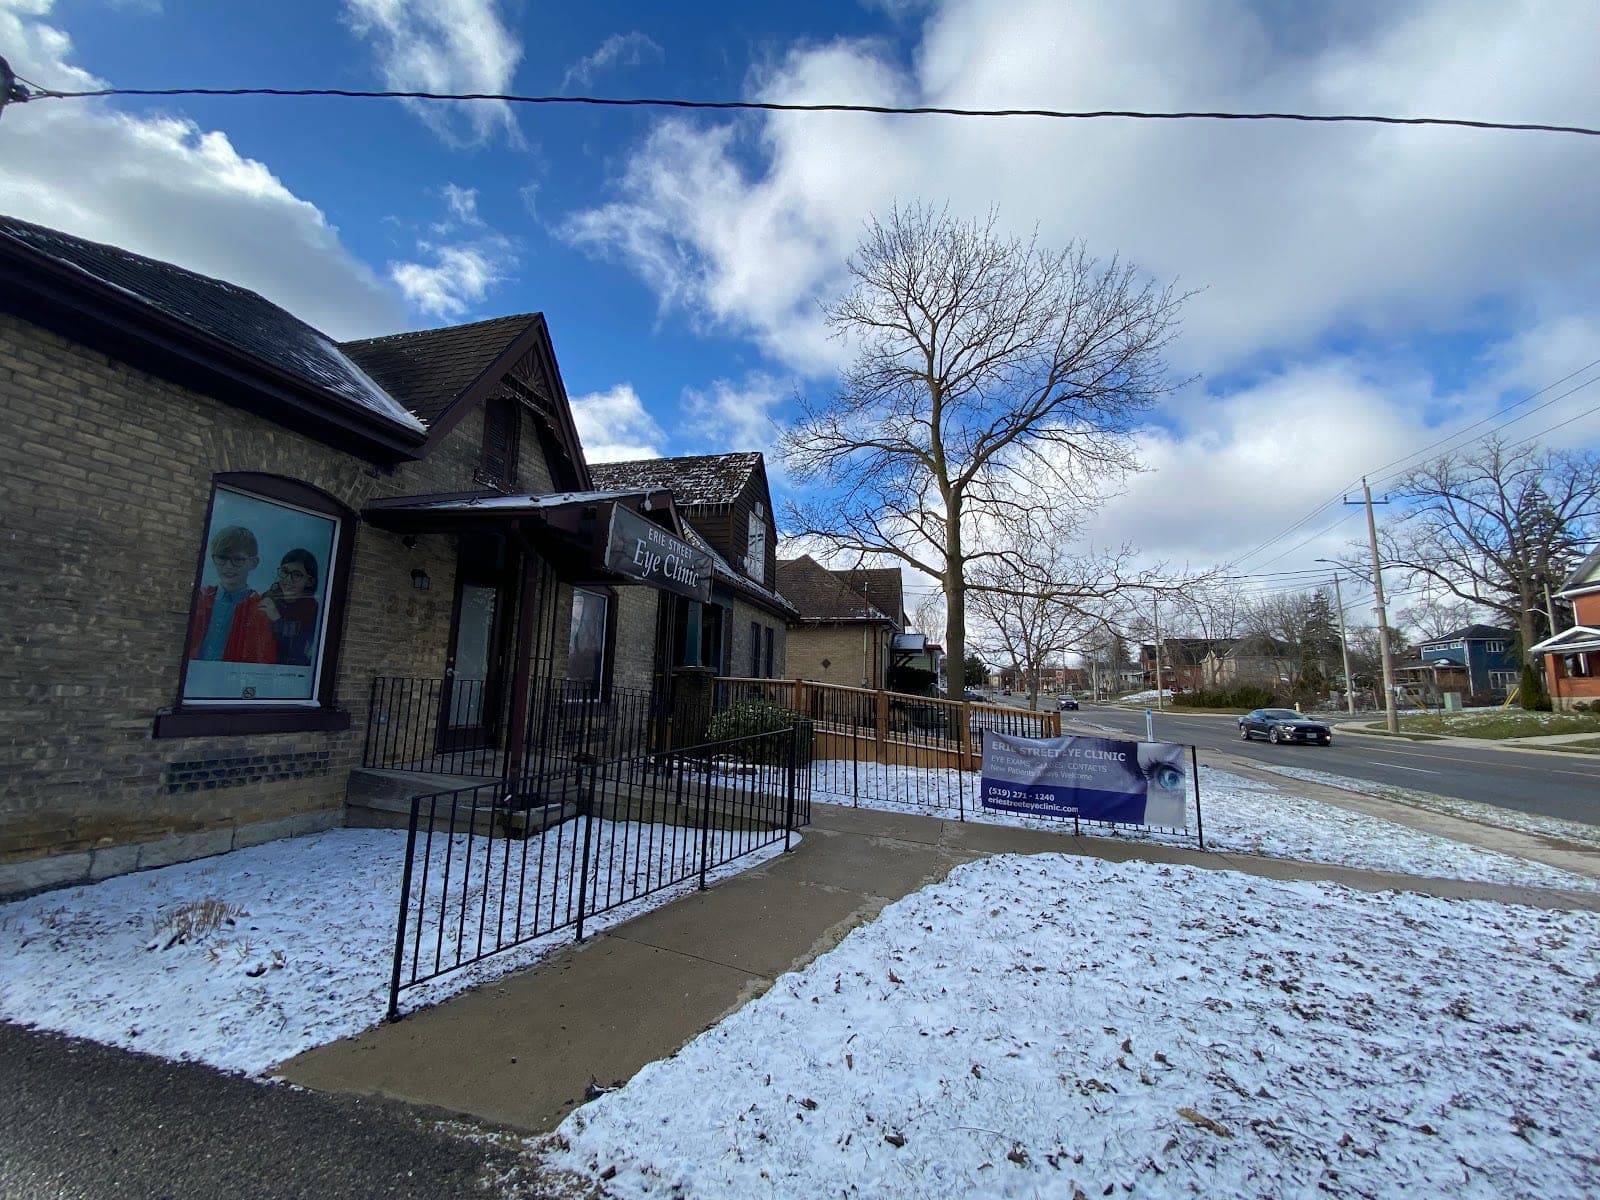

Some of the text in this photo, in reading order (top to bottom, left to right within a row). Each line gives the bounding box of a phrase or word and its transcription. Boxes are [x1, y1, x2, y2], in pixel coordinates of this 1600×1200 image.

[648, 527, 693, 559] ERIE STREET
[633, 538, 699, 588] Eye Clinic
[1019, 747, 1060, 758] STREET
[1062, 748, 1081, 758] YE
[1084, 749, 1127, 762] CLINIC
[988, 786, 1011, 799] (519)
[1012, 791, 1028, 799] 271
[1035, 793, 1055, 802] 1240
[987, 796, 1079, 813] eriestreeteyeclinic.com
